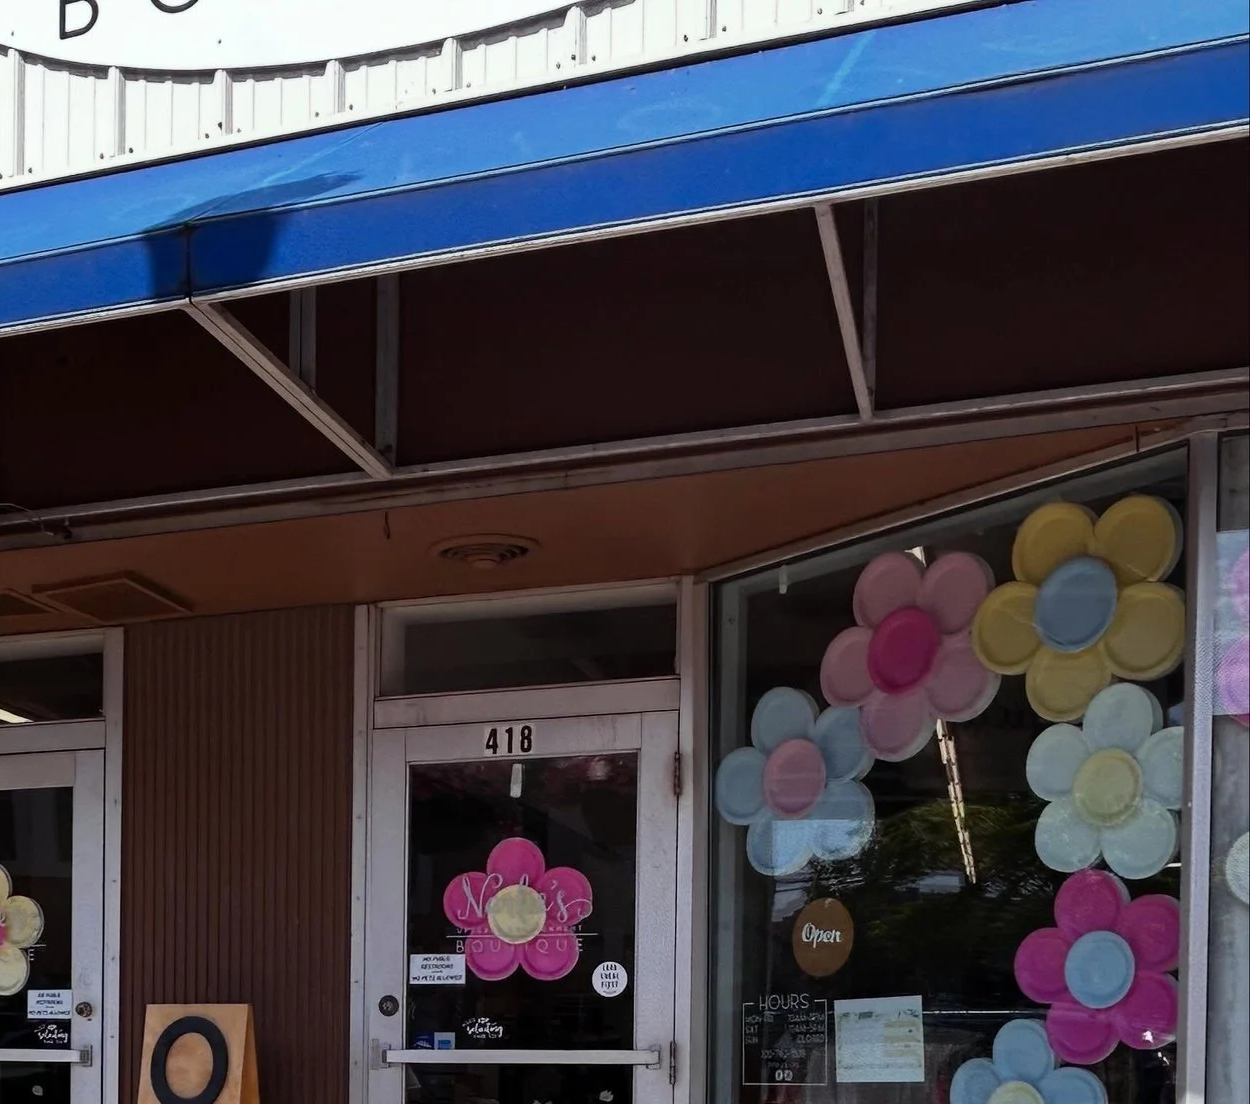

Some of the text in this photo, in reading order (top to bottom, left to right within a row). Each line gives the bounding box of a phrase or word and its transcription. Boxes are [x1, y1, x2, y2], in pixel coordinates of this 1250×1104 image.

[485, 725, 534, 755] 418
[802, 923, 842, 948] Open
[759, 993, 810, 1011] HOURS
